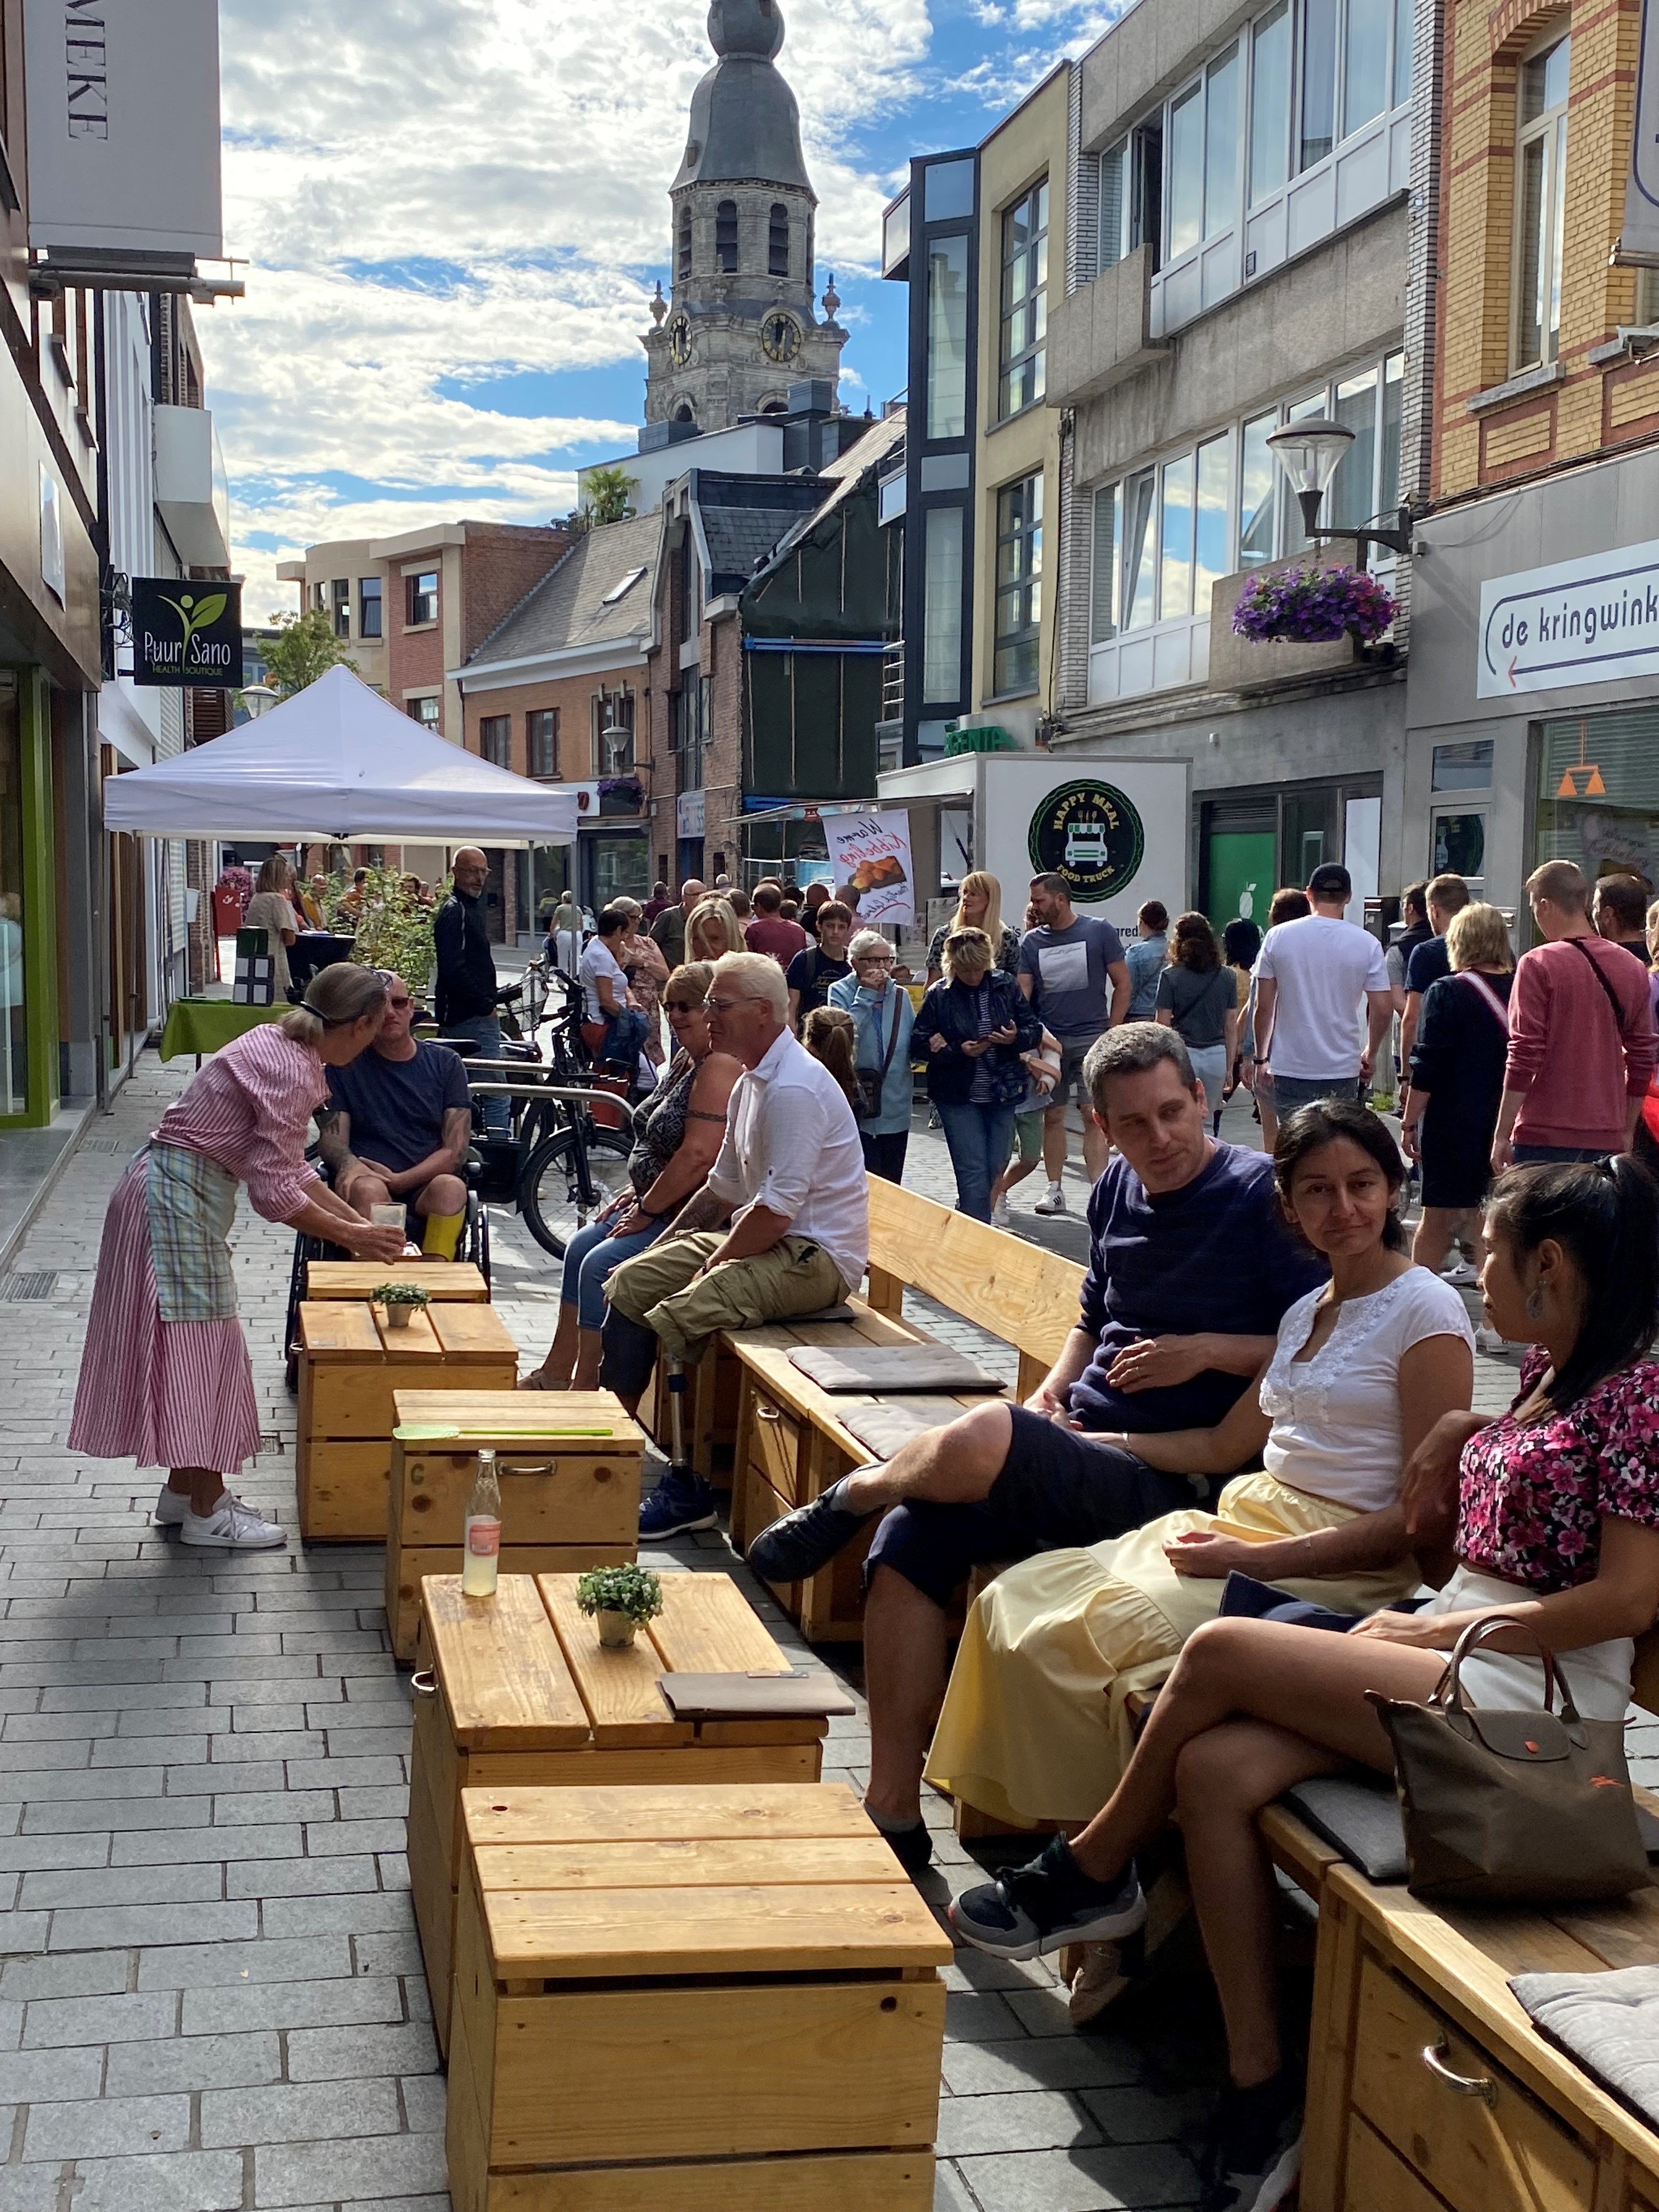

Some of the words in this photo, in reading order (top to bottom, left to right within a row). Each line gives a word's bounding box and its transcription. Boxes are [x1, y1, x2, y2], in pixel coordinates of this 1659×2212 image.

[1502, 613, 1528, 648] de
[1539, 585, 1658, 644] kringwink
[144, 631, 182, 662] Puur
[191, 633, 231, 665] Sano
[153, 665, 181, 674] HEALTH
[184, 666, 224, 676] BOUTIQUE
[1053, 792, 1086, 830] HAPPY
[1092, 793, 1120, 830] MEAL
[1057, 863, 1081, 883] FOOD
[1082, 865, 1115, 883] TRUCK
